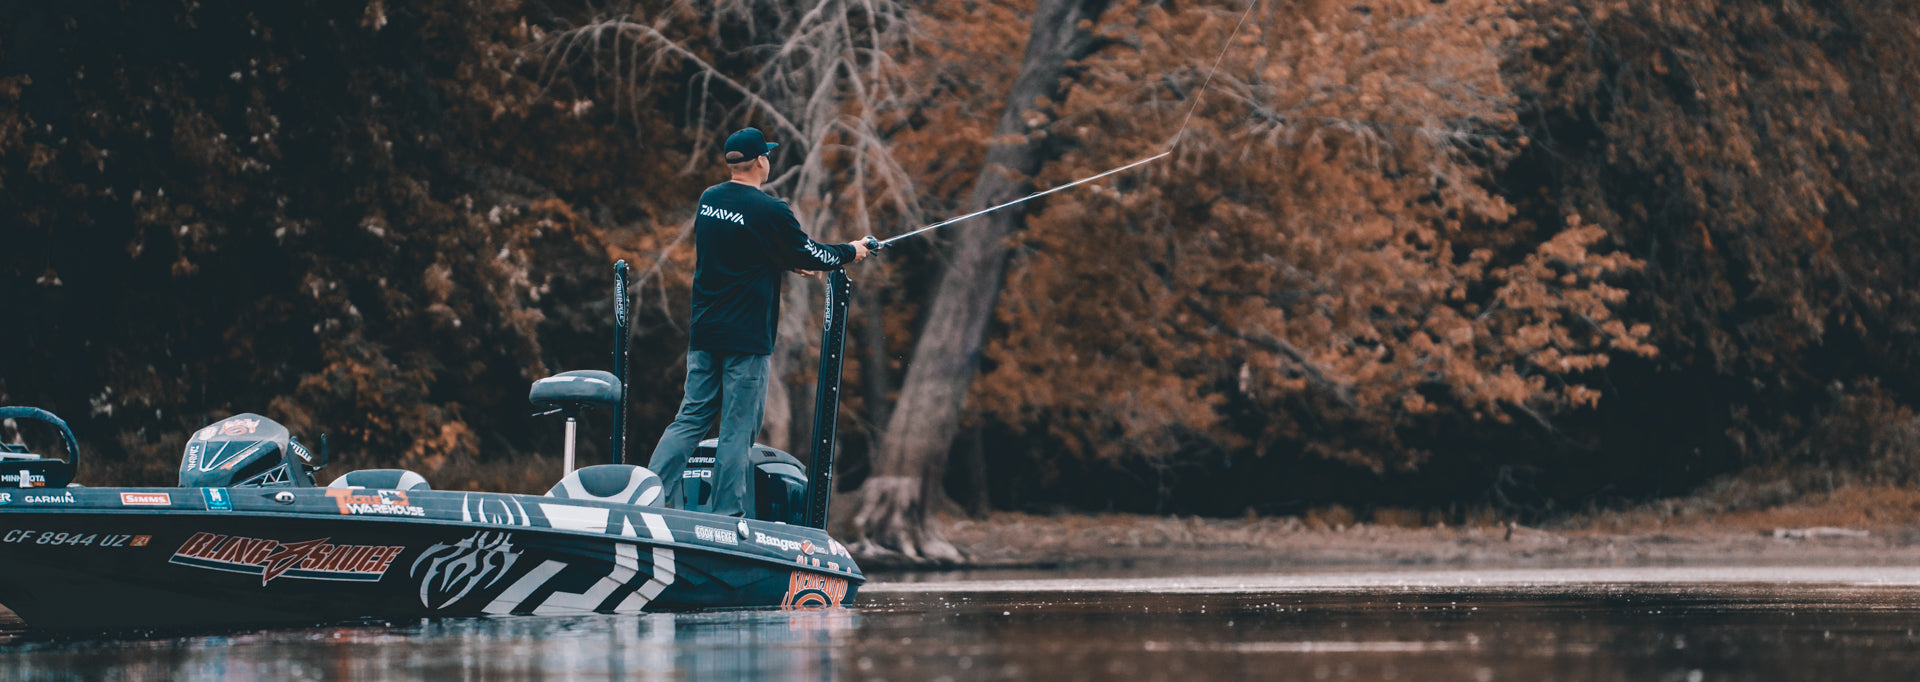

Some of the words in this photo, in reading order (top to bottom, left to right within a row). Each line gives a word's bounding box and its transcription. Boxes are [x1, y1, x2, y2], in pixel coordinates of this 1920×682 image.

[700, 204, 744, 225] DAIWA
[682, 470, 712, 479] 250
[25, 491, 75, 504] GARMIN
[125, 495, 167, 503] SIMMS
[325, 489, 382, 515] TACKLE
[346, 503, 425, 516] WAREHOUSE
[3, 530, 36, 543] CF
[36, 531, 98, 546] 8944
[100, 534, 133, 547] UZ
[714, 528, 738, 545] MEYER
[755, 531, 802, 551] Ranger
[175, 531, 279, 566] BLING
[300, 543, 406, 575] SAUCE
